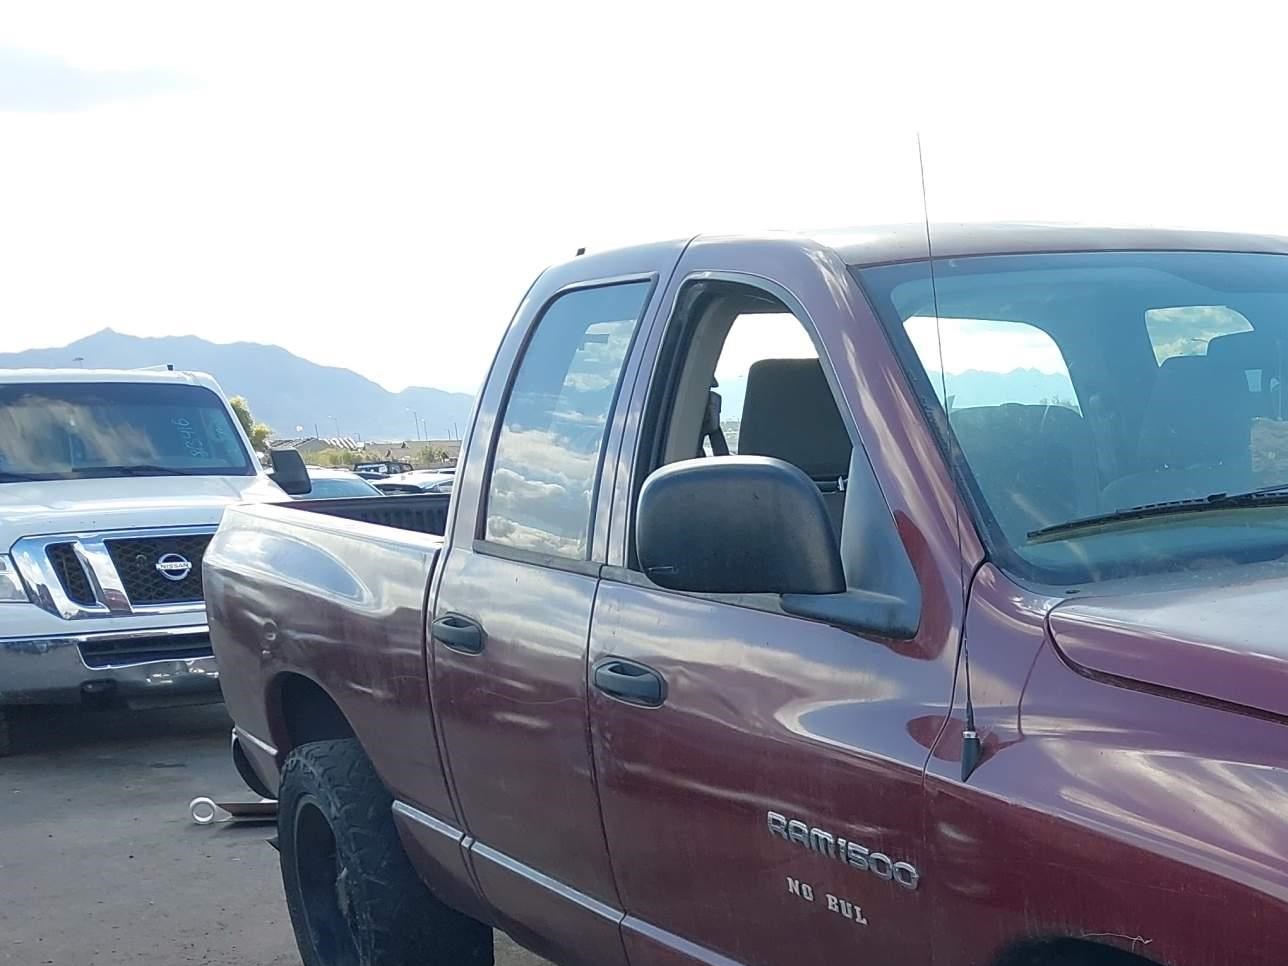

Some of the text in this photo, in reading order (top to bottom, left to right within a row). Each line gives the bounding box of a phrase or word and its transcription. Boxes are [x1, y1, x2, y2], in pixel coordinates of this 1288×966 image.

[160, 562, 189, 570] NISSAN
[786, 876, 869, 926] NO BUL
